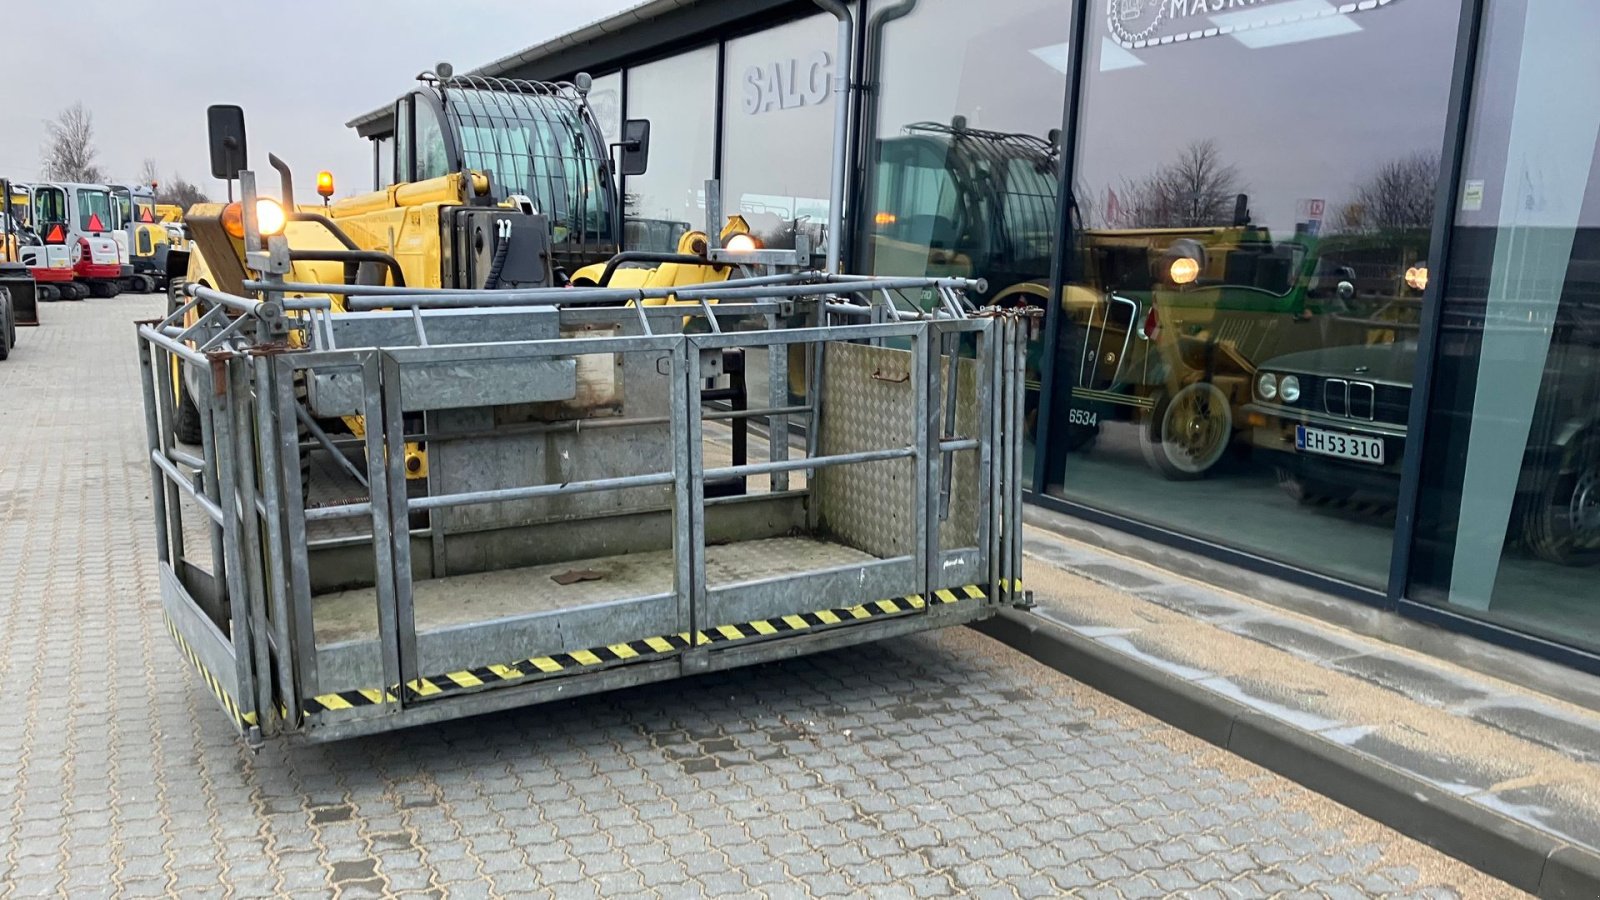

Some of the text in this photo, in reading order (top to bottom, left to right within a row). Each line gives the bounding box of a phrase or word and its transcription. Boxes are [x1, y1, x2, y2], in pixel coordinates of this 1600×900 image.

[742, 49, 831, 116] SALG
[1069, 408, 1097, 427] 6534
[1306, 431, 1381, 459] EH 53 310
